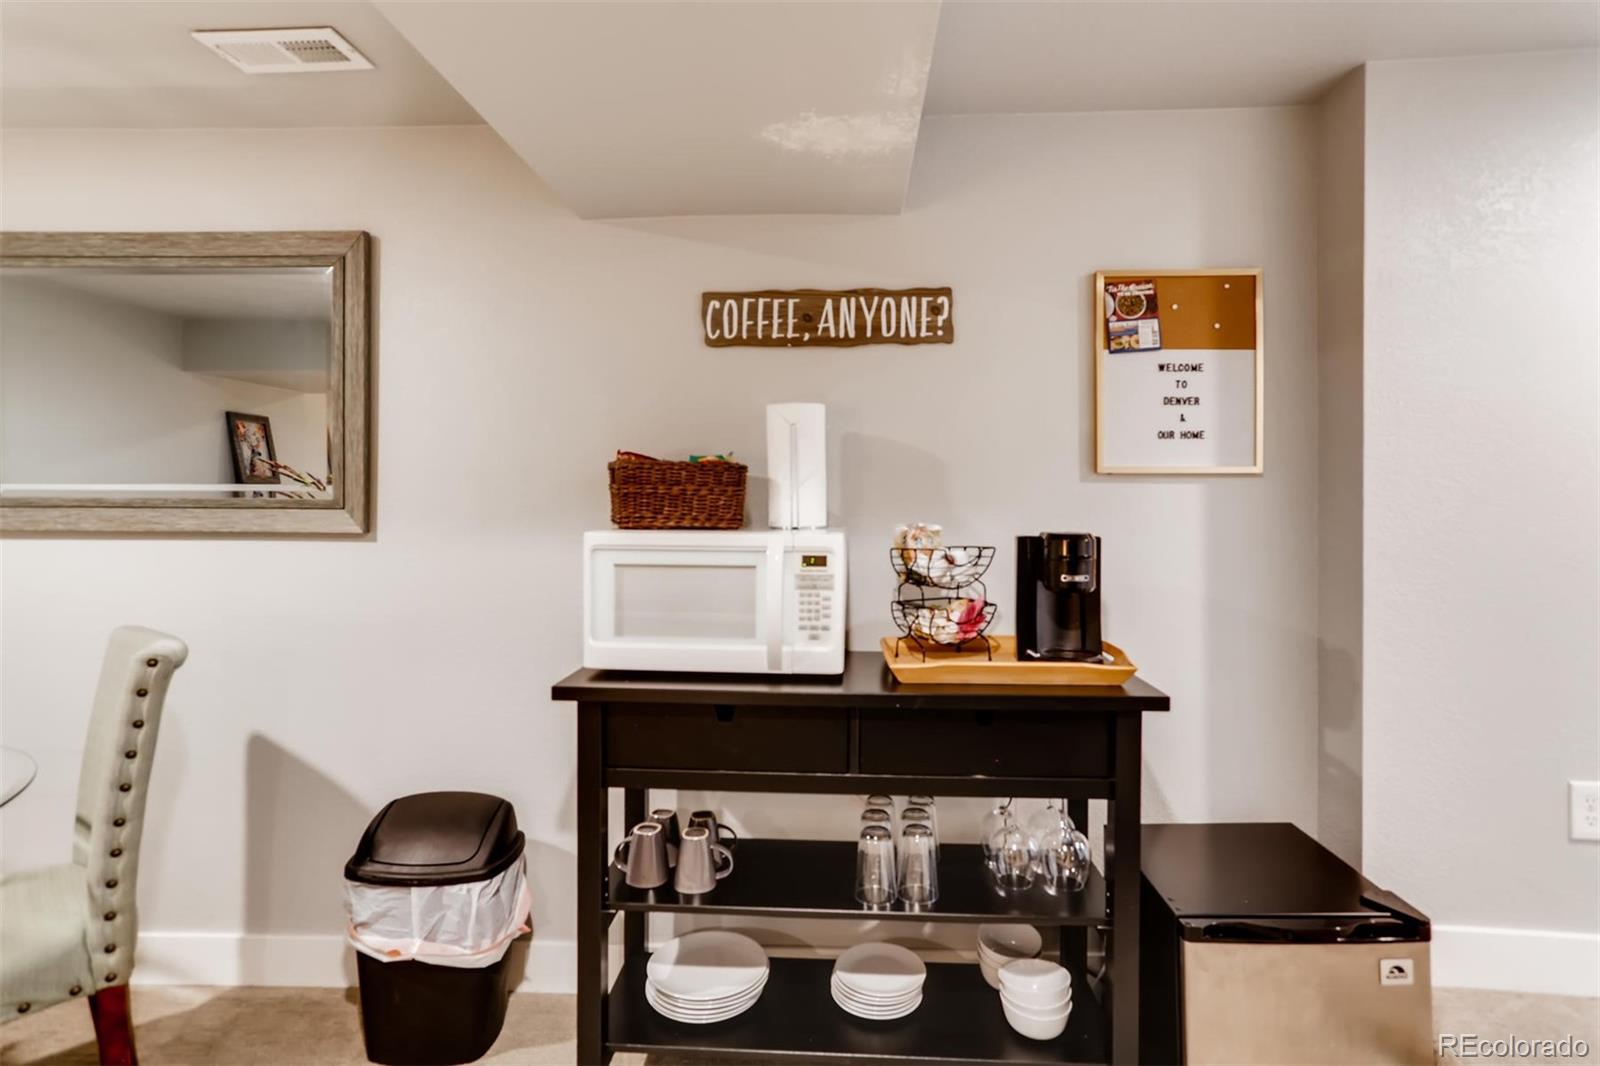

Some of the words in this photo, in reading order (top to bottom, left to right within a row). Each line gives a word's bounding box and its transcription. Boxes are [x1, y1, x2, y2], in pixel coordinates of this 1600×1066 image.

[705, 297, 810, 341] COFFEE,
[817, 296, 950, 339] ANYONE?
[1158, 362, 1205, 373] WELCOME
[1175, 379, 1188, 389] TO
[1163, 396, 1200, 406] DENVER
[1179, 413, 1186, 422] &
[1157, 430, 1175, 440] OUR
[1180, 430, 1205, 440] HOME
